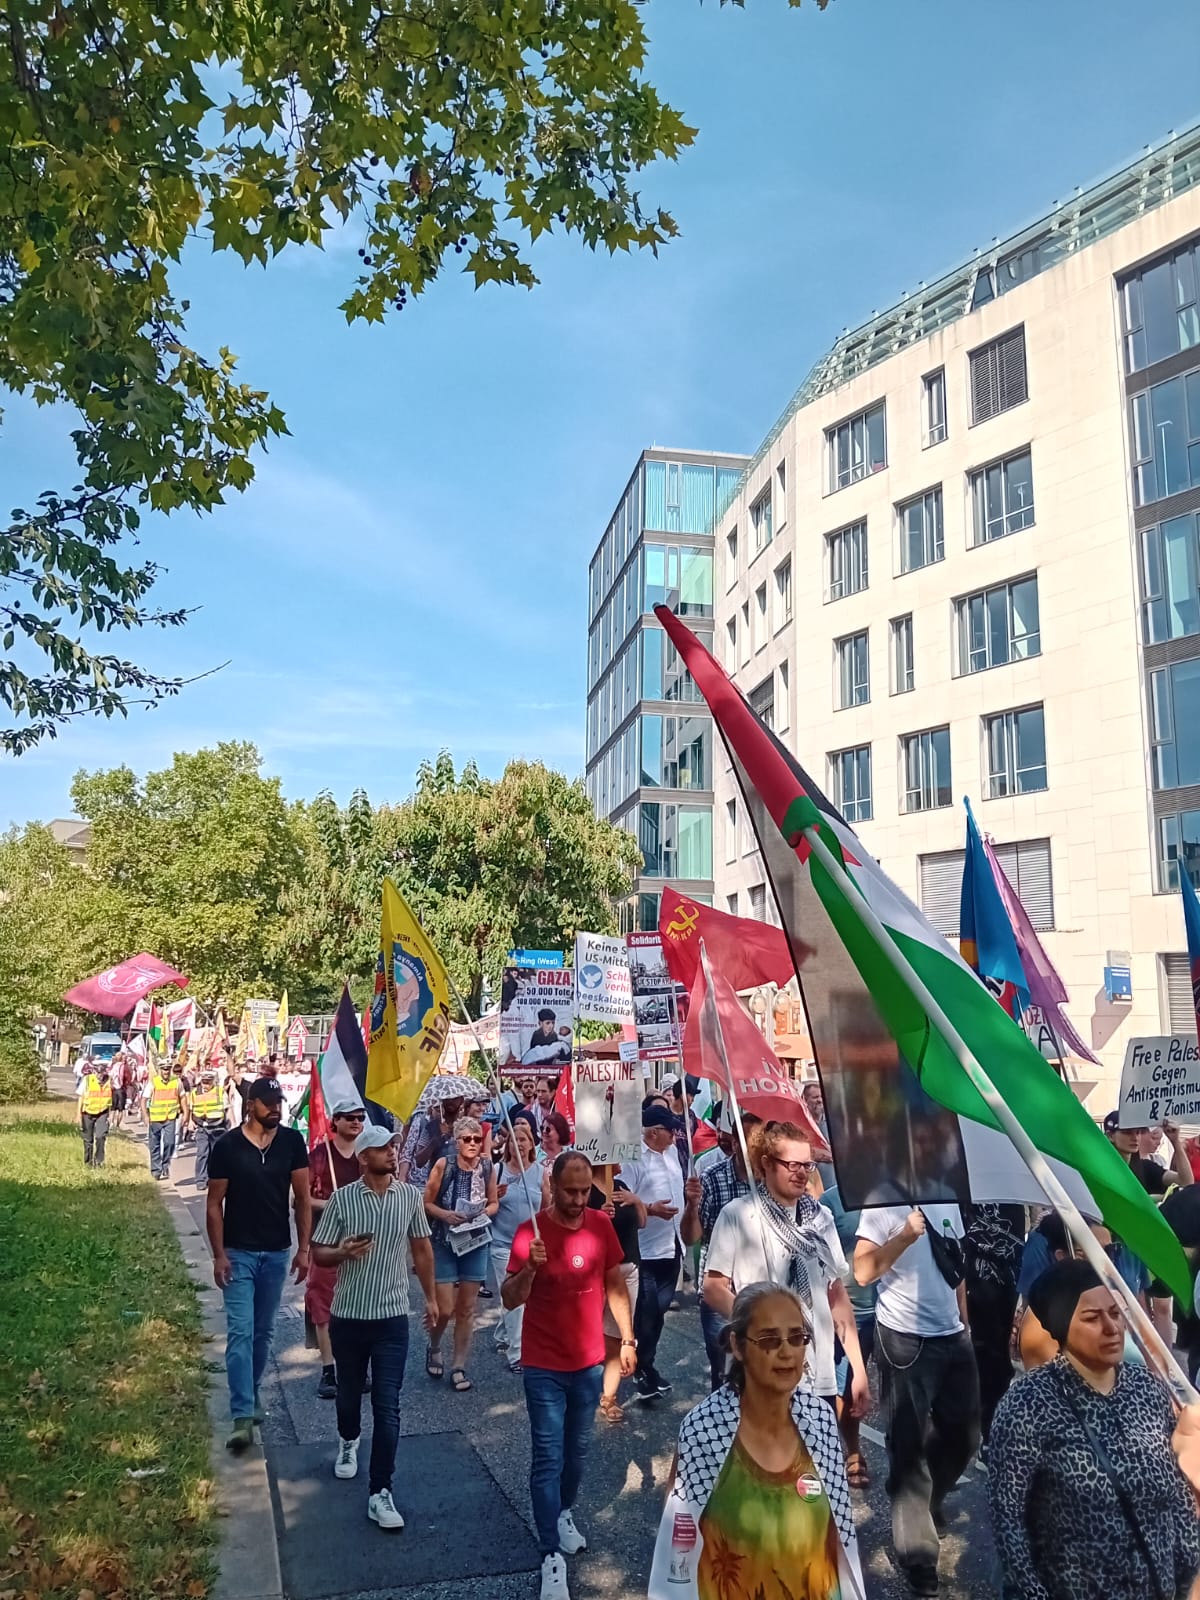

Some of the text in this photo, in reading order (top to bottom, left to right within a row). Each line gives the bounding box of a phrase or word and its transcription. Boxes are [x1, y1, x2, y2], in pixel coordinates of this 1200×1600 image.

[587, 940, 619, 954] Keine
[537, 957, 558, 966] (West)
[537, 970, 571, 986] GAZA
[555, 988, 571, 996] Tote
[1131, 1044, 1162, 1068] Free
[576, 1061, 637, 1082] PALESTINE
[1151, 1065, 1187, 1085] Gegen
[1149, 1100, 1160, 1120] &
[576, 1138, 598, 1151] will
[593, 1143, 641, 1161] be FREE
